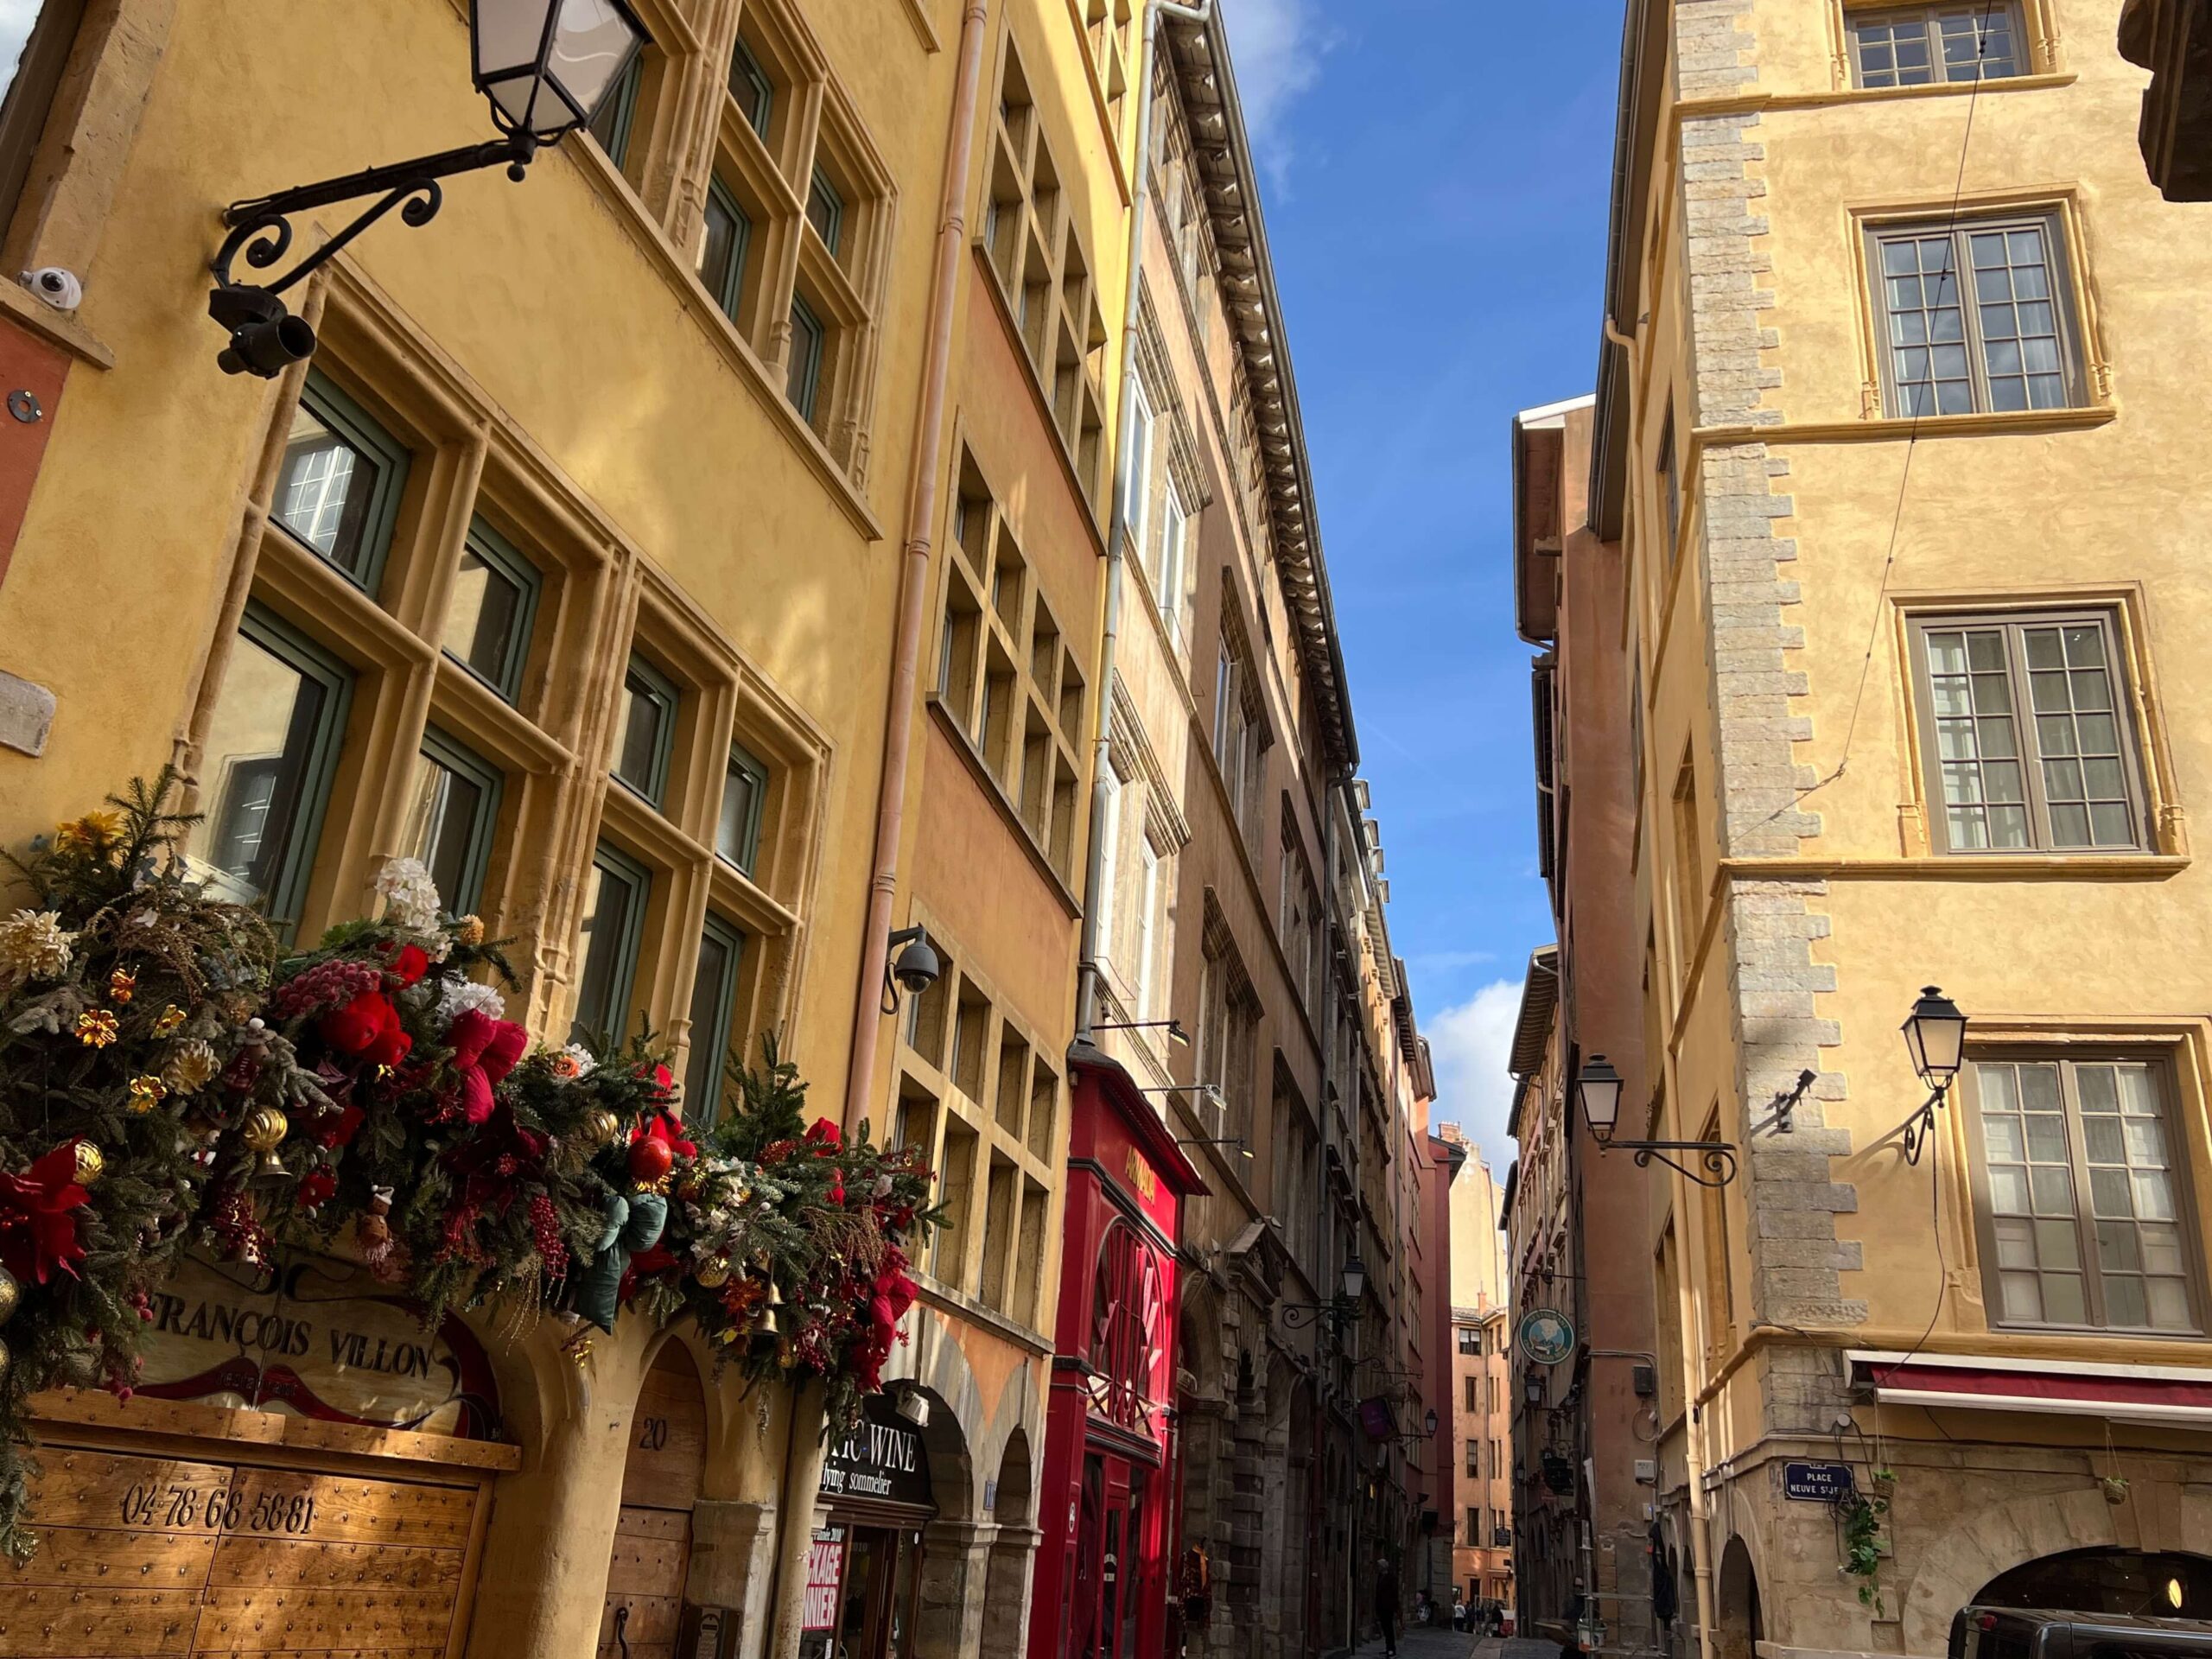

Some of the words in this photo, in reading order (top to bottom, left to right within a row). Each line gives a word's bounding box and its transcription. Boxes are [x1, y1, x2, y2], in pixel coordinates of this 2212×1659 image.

[330, 1329, 432, 1380] VILLON
[639, 1417, 667, 1451] 20
[869, 1423, 917, 1472] WINE
[822, 1460, 846, 1494] lying
[849, 1469, 892, 1496] sommelier
[1790, 1484, 1816, 1493] NEUVE
[1806, 1472, 1832, 1482] PLACE
[122, 1482, 157, 1527] 04
[165, 1484, 197, 1528] 78
[205, 1488, 243, 1530] 68
[807, 1543, 842, 1586] CKAGE
